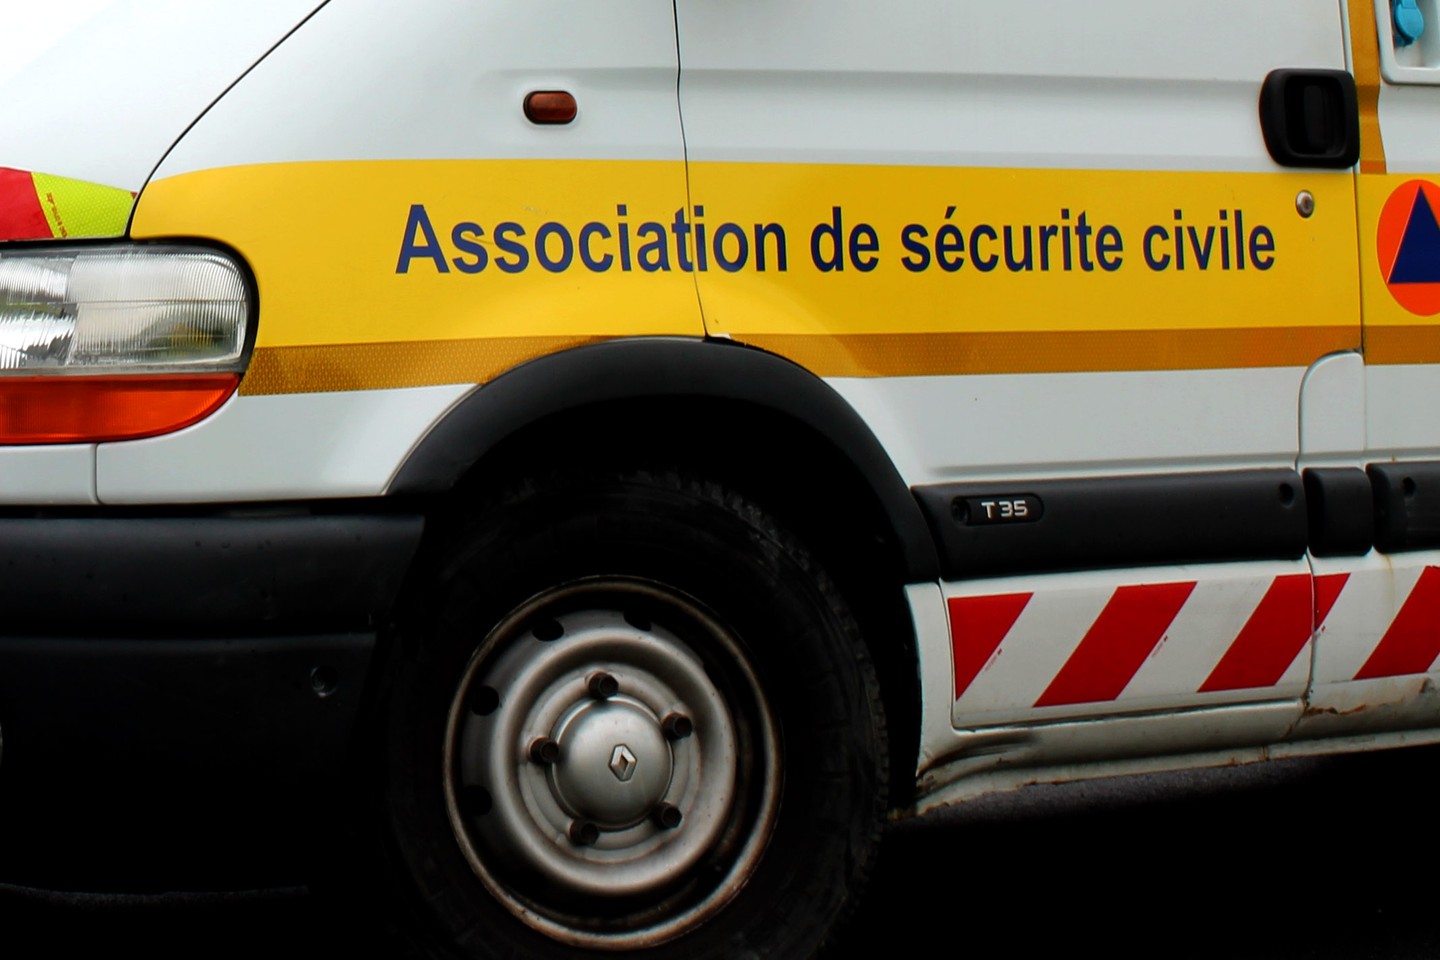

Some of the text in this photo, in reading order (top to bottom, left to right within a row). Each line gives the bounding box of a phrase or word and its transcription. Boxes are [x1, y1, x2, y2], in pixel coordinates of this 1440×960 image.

[394, 203, 1276, 274] Association de sécurite civile
